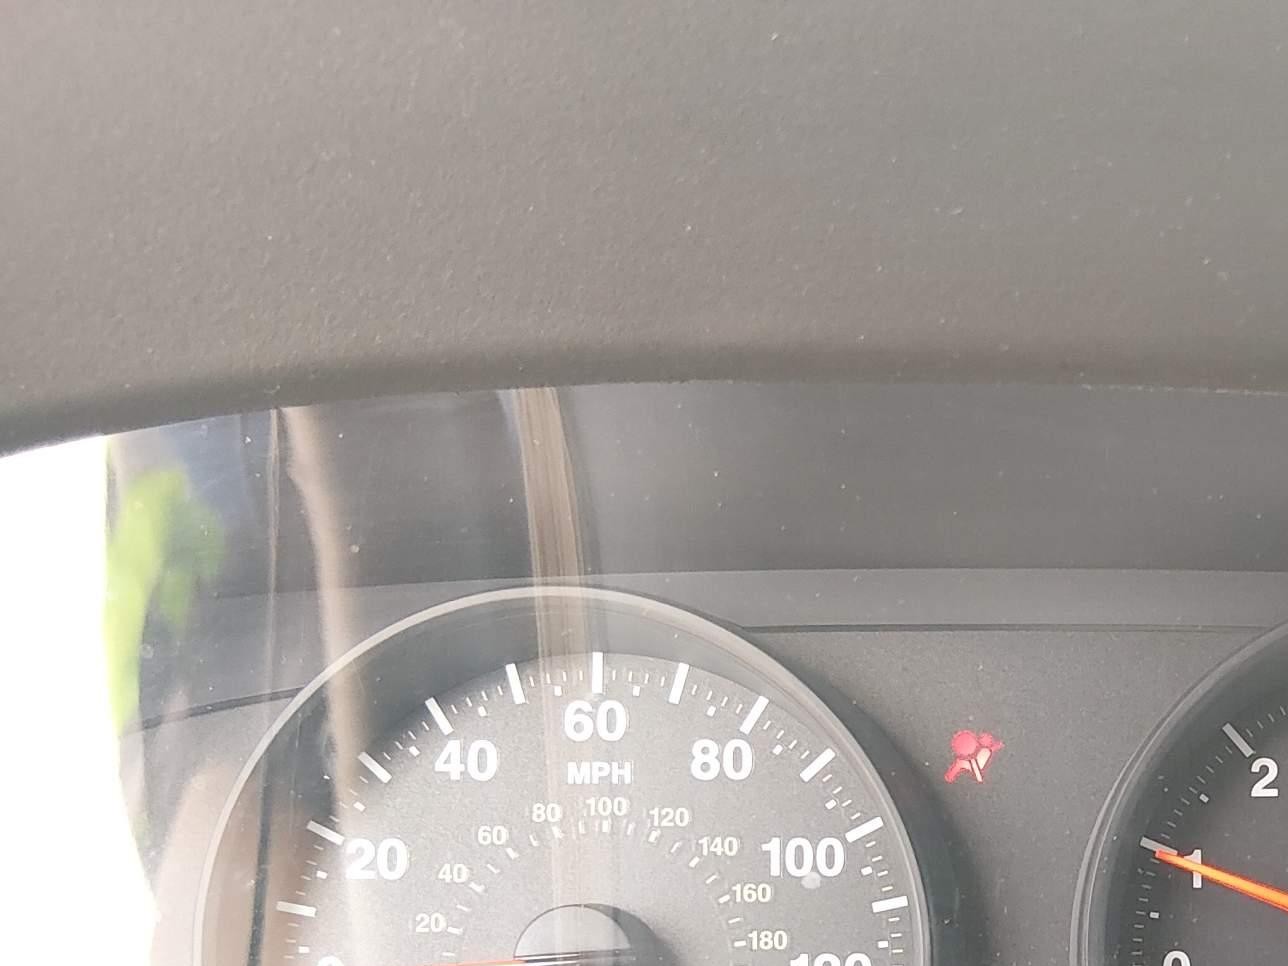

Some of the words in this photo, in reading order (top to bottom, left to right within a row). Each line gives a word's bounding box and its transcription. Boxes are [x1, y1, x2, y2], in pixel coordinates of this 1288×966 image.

[563, 700, 628, 741] 60
[434, 740, 498, 781] 40
[690, 740, 754, 780] 80
[567, 761, 633, 785] MPH
[1250, 758, 1279, 798] 2
[532, 803, 561, 822] 80
[585, 797, 628, 817] 100
[650, 807, 690, 827] 120
[478, 826, 507, 846] 60
[699, 836, 738, 856] 140
[345, 839, 409, 880] 20
[761, 838, 845, 877] 100
[438, 863, 467, 883] 40
[1183, 849, 1202, 888] 1
[732, 883, 772, 903] 160
[415, 913, 445, 933] 20
[748, 930, 787, 950] 180
